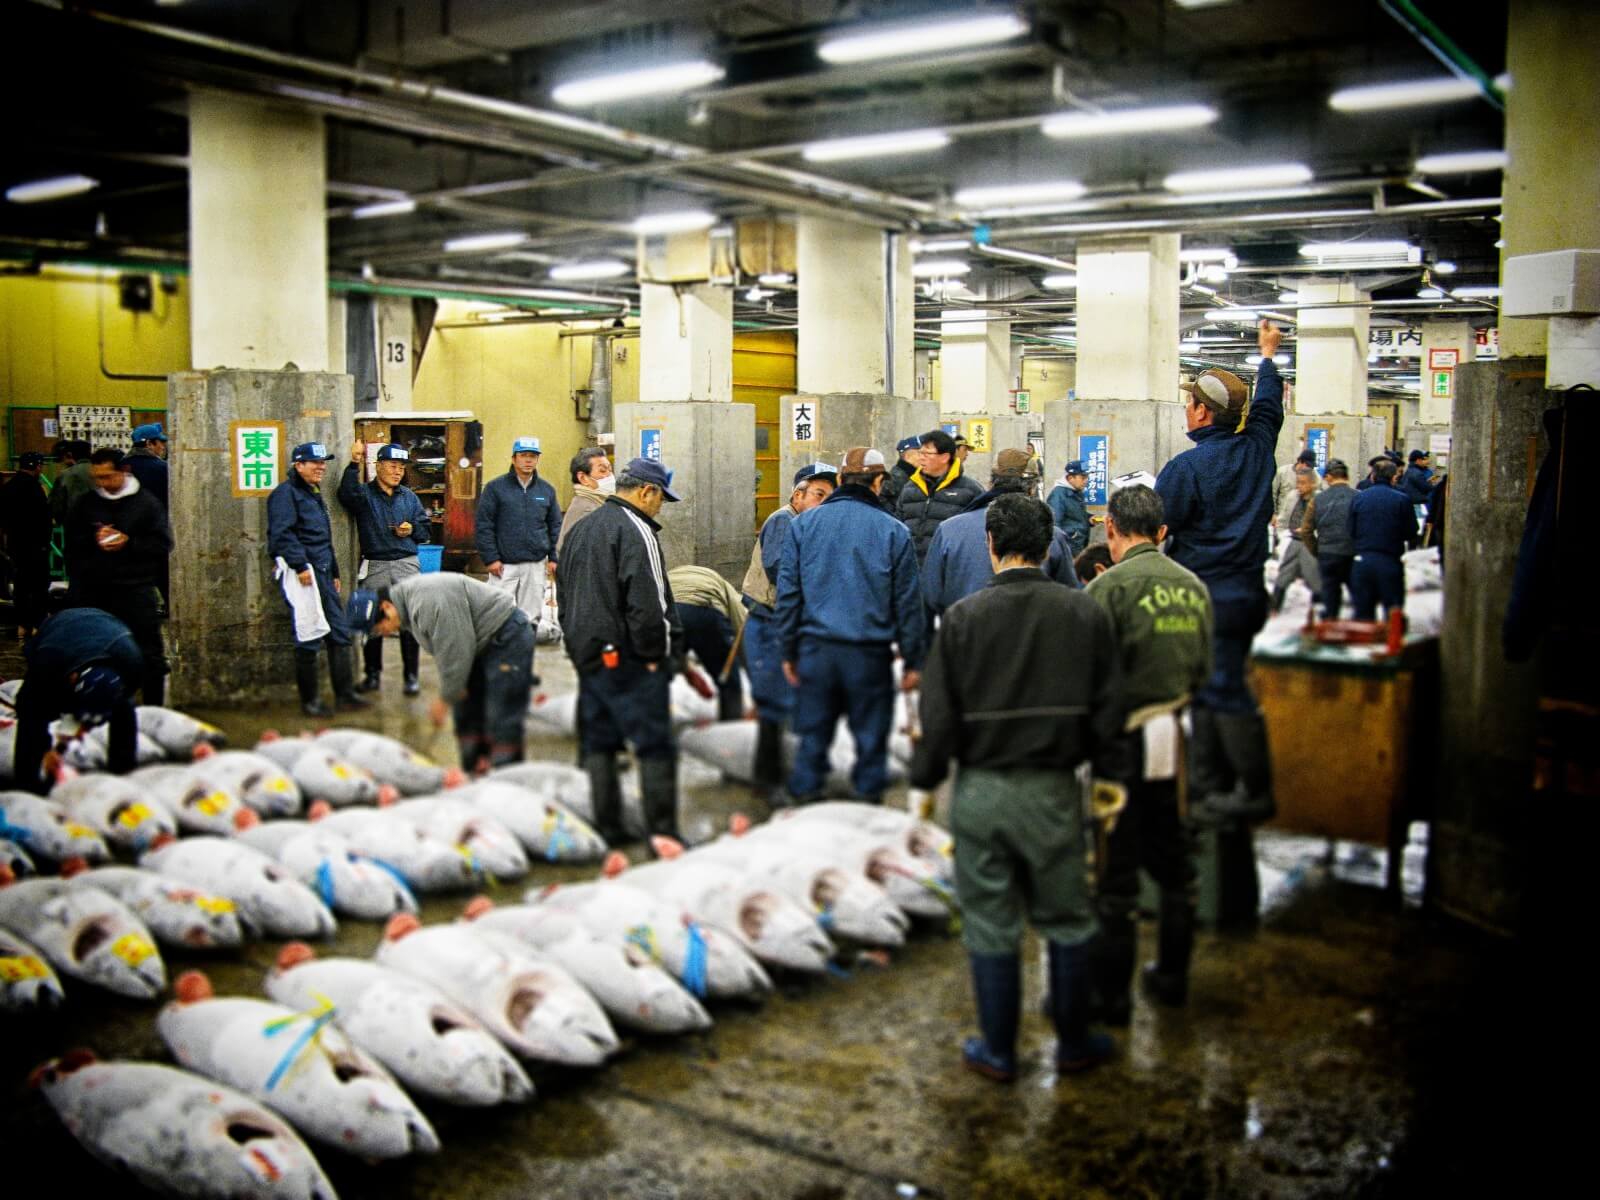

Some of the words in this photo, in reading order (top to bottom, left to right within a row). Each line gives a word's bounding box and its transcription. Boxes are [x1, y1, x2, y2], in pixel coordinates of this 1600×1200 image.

[387, 342, 405, 362] 13
[796, 403, 811, 440] 大都
[242, 431, 274, 488] 東市
